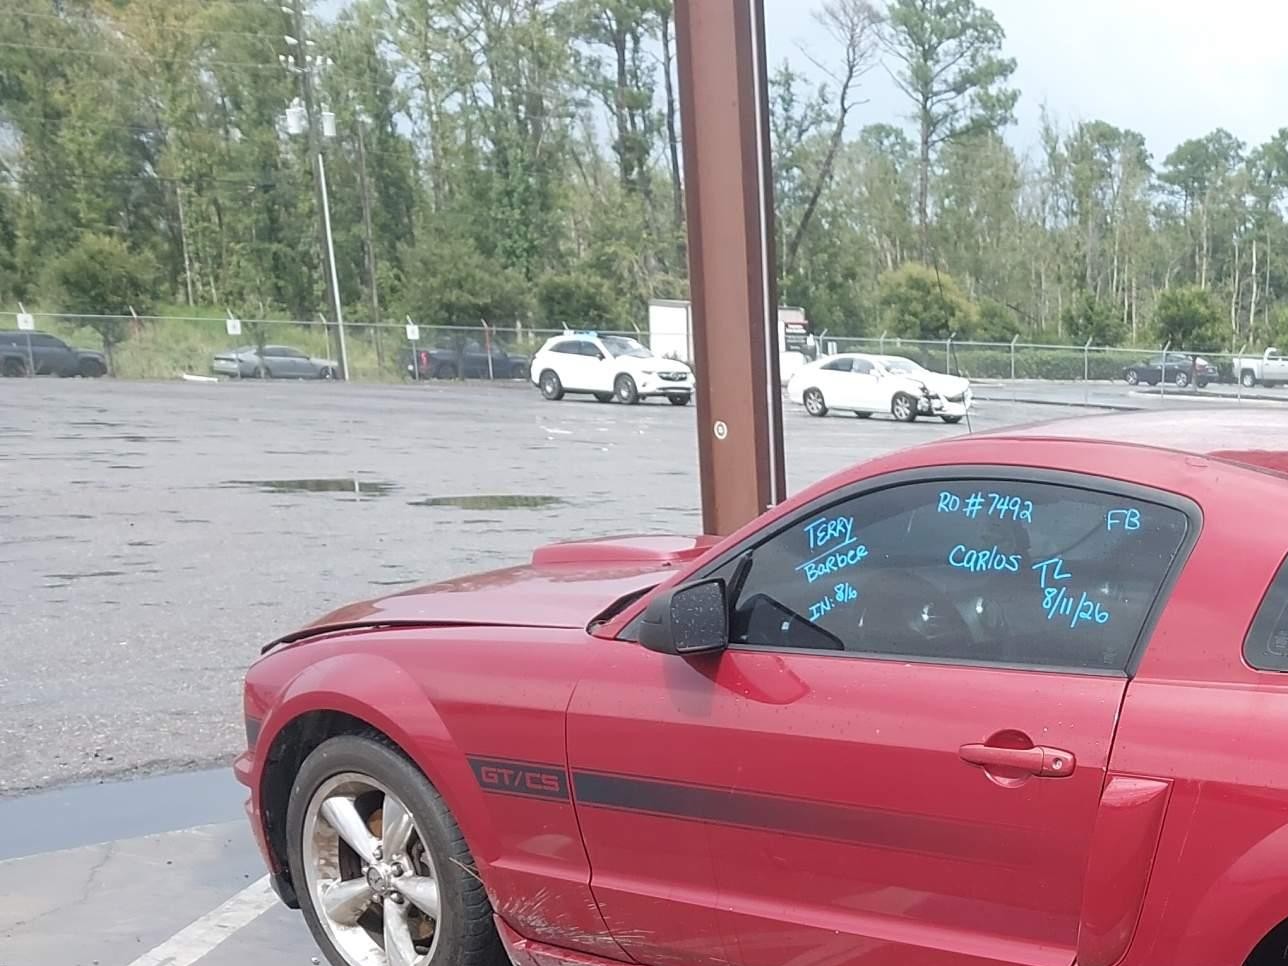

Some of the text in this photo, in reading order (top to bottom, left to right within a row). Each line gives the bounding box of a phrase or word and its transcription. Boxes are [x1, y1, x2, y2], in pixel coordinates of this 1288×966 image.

[936, 491, 961, 513] RO
[803, 516, 855, 549] TERRY
[1106, 508, 1142, 532] FB
[1031, 558, 1073, 588] TL
[808, 582, 858, 622] IN: 8/6
[1041, 587, 1110, 629] 8/11/26
[480, 765, 562, 793] GT/CS
